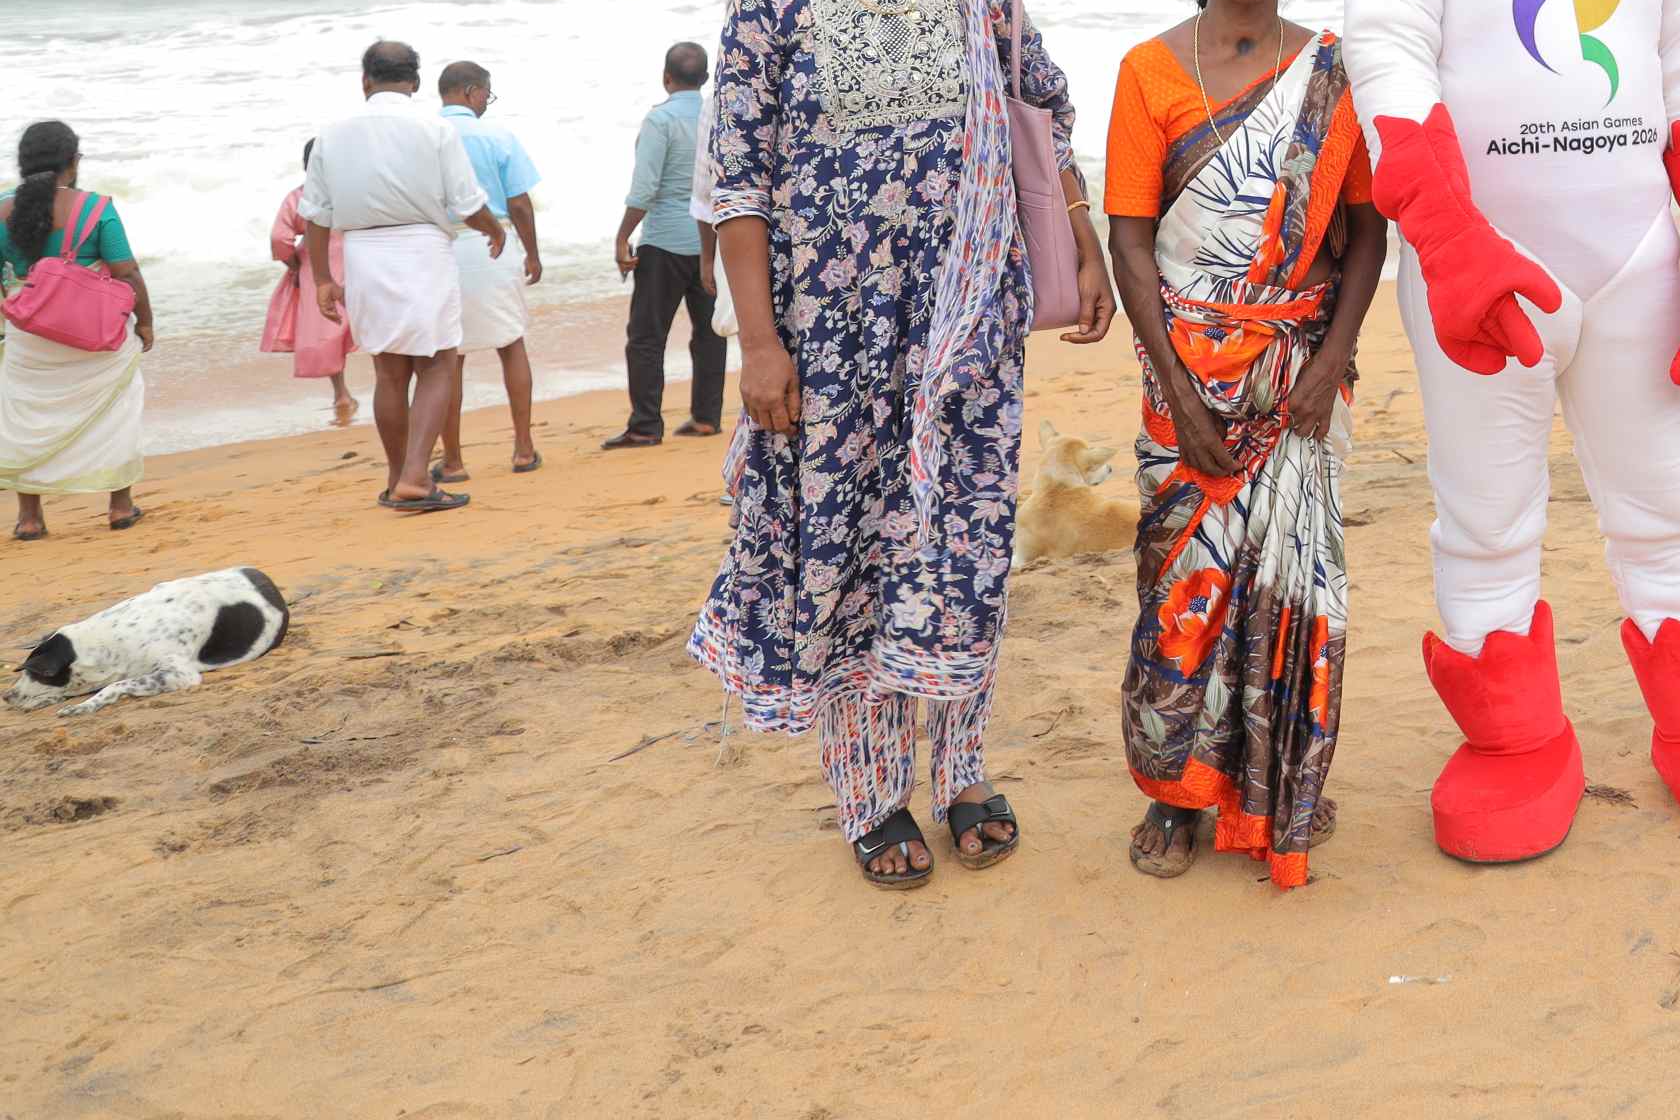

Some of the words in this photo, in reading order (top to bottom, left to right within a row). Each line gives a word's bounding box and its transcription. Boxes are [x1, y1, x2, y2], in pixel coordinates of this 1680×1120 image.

[1520, 122, 1556, 135] 20th
[1560, 118, 1599, 132] Asian
[1603, 117, 1643, 129] Games
[1486, 133, 1628, 155] Aichi-Nagoya
[1631, 127, 1658, 146] 2026
